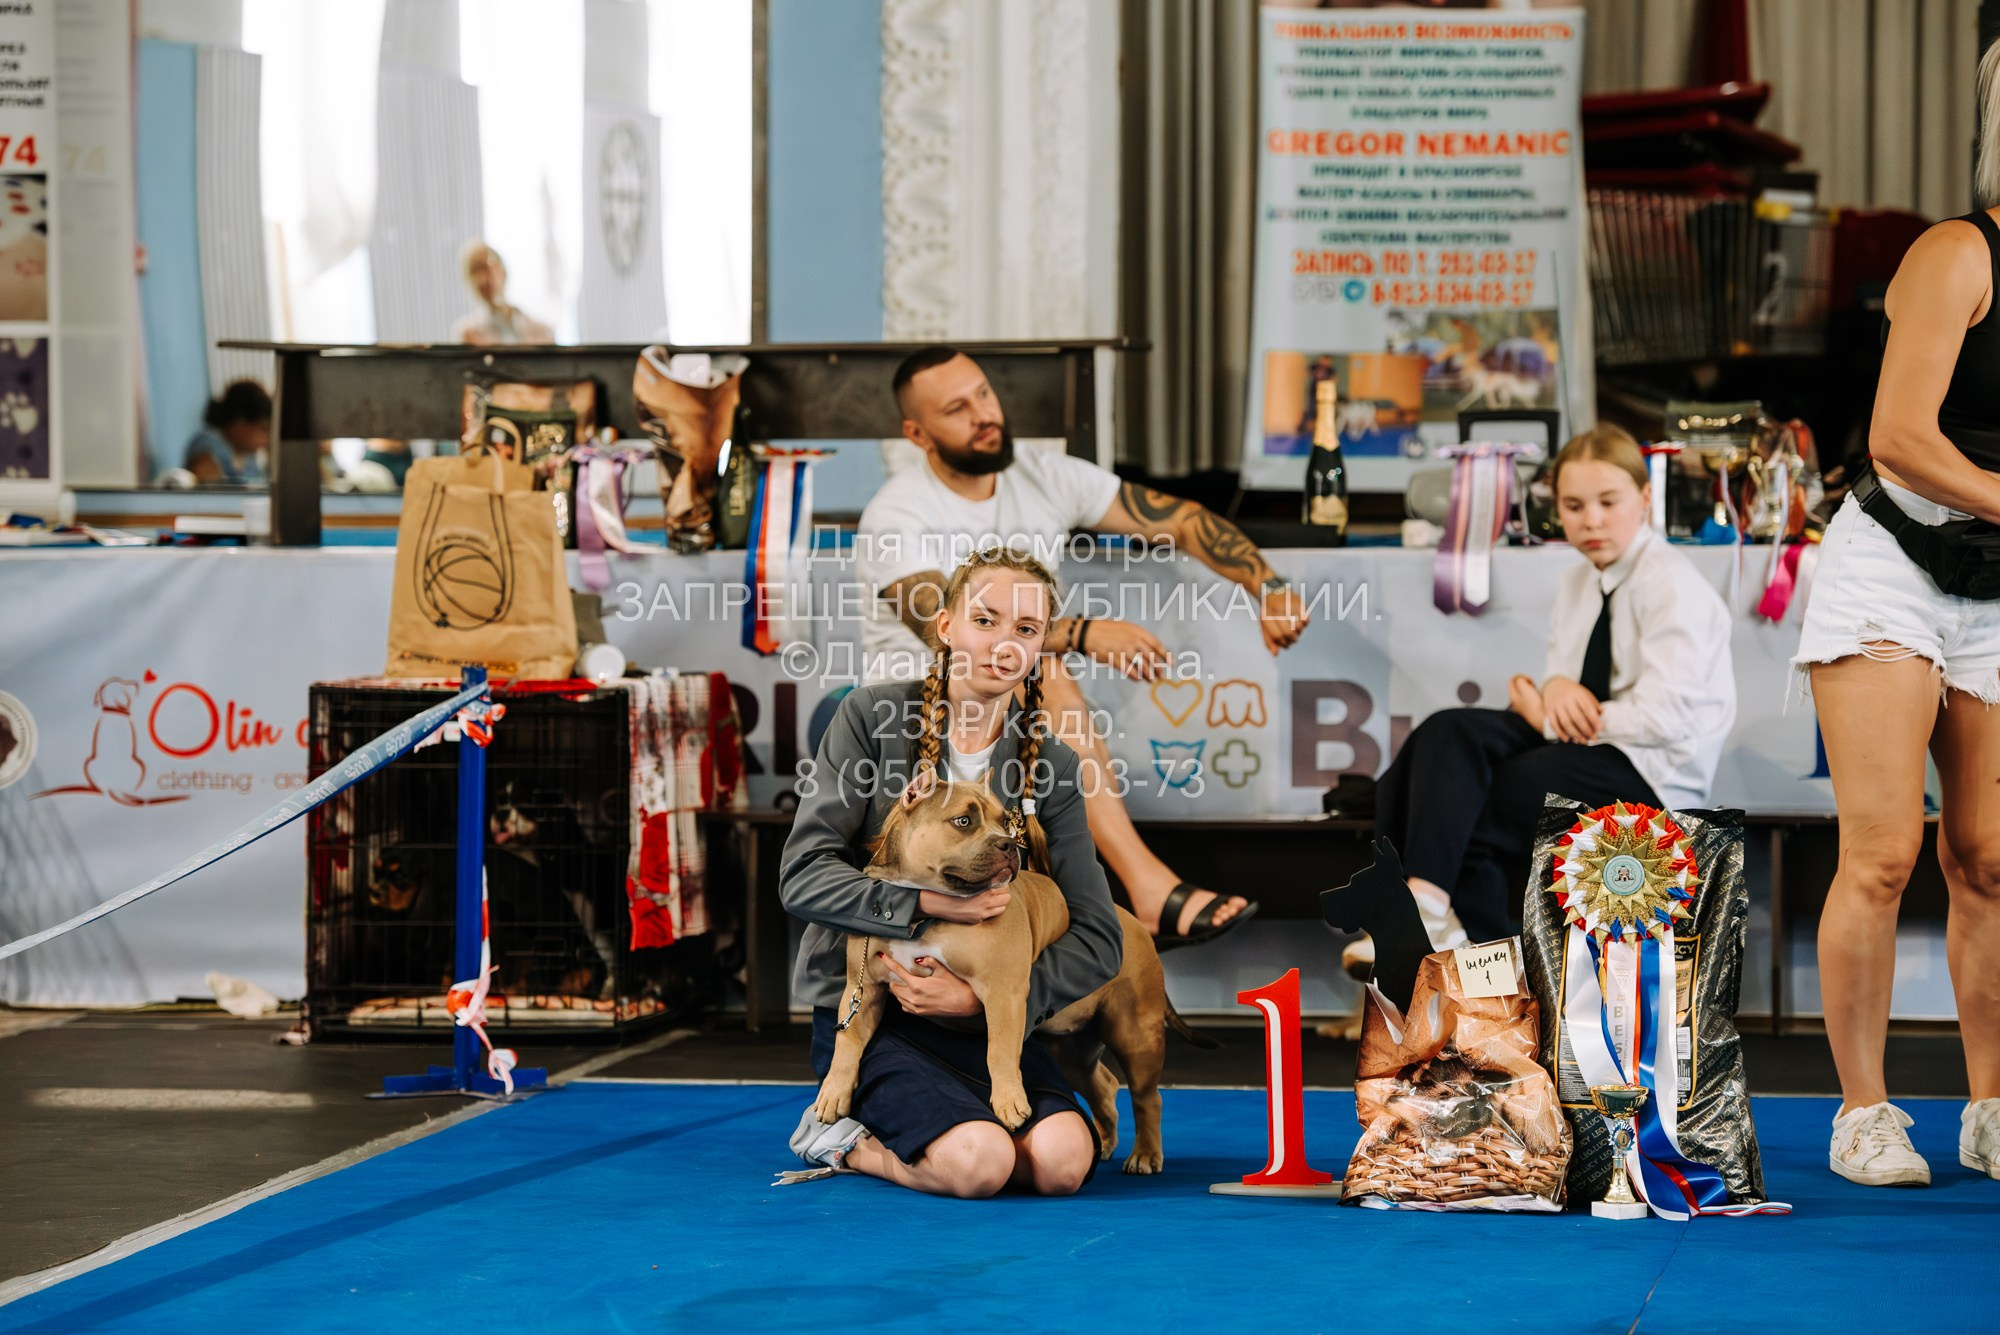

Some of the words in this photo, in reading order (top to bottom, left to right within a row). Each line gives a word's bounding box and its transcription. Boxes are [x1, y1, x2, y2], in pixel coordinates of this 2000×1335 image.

[1267, 130, 1405, 157] GREGOR
[1416, 130, 1571, 157] NEMANIC
[1292, 250, 1375, 276] ЗАПИСЬ
[147, 682, 283, 760] Olin
[157, 769, 253, 795] clothing
[1237, 968, 1332, 1185] 1
